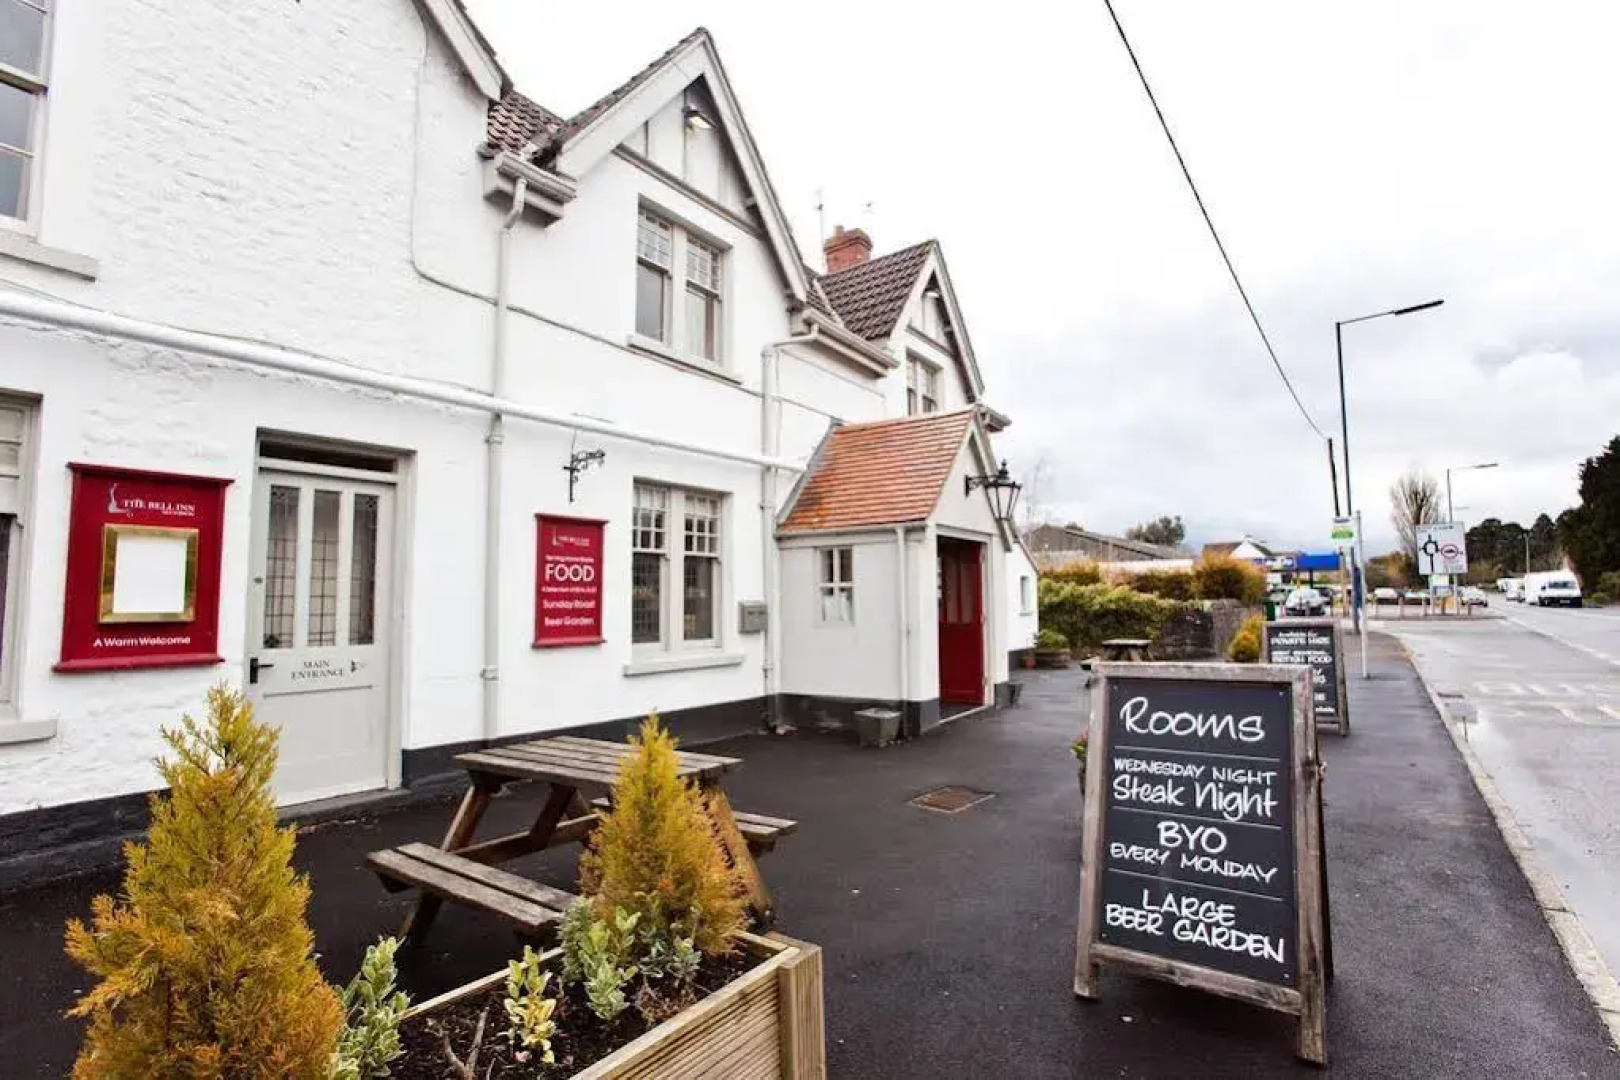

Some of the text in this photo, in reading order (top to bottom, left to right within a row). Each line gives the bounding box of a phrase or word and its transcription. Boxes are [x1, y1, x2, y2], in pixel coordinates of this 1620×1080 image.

[544, 563, 595, 582] FOOD
[93, 635, 191, 647] A Warm Welcome
[290, 668, 345, 680] ENTRANCE
[303, 660, 330, 669] MAIN
[1119, 696, 1265, 742] Rooms
[1114, 757, 1278, 786] WEDNESDAY NIGHT
[1113, 773, 1279, 822] Steak Night
[1157, 821, 1227, 853] BYO
[1110, 842, 1279, 883] EVERY MONDAY
[1142, 888, 1236, 926] LARGE
[1105, 903, 1285, 963] BEER GARDEN
